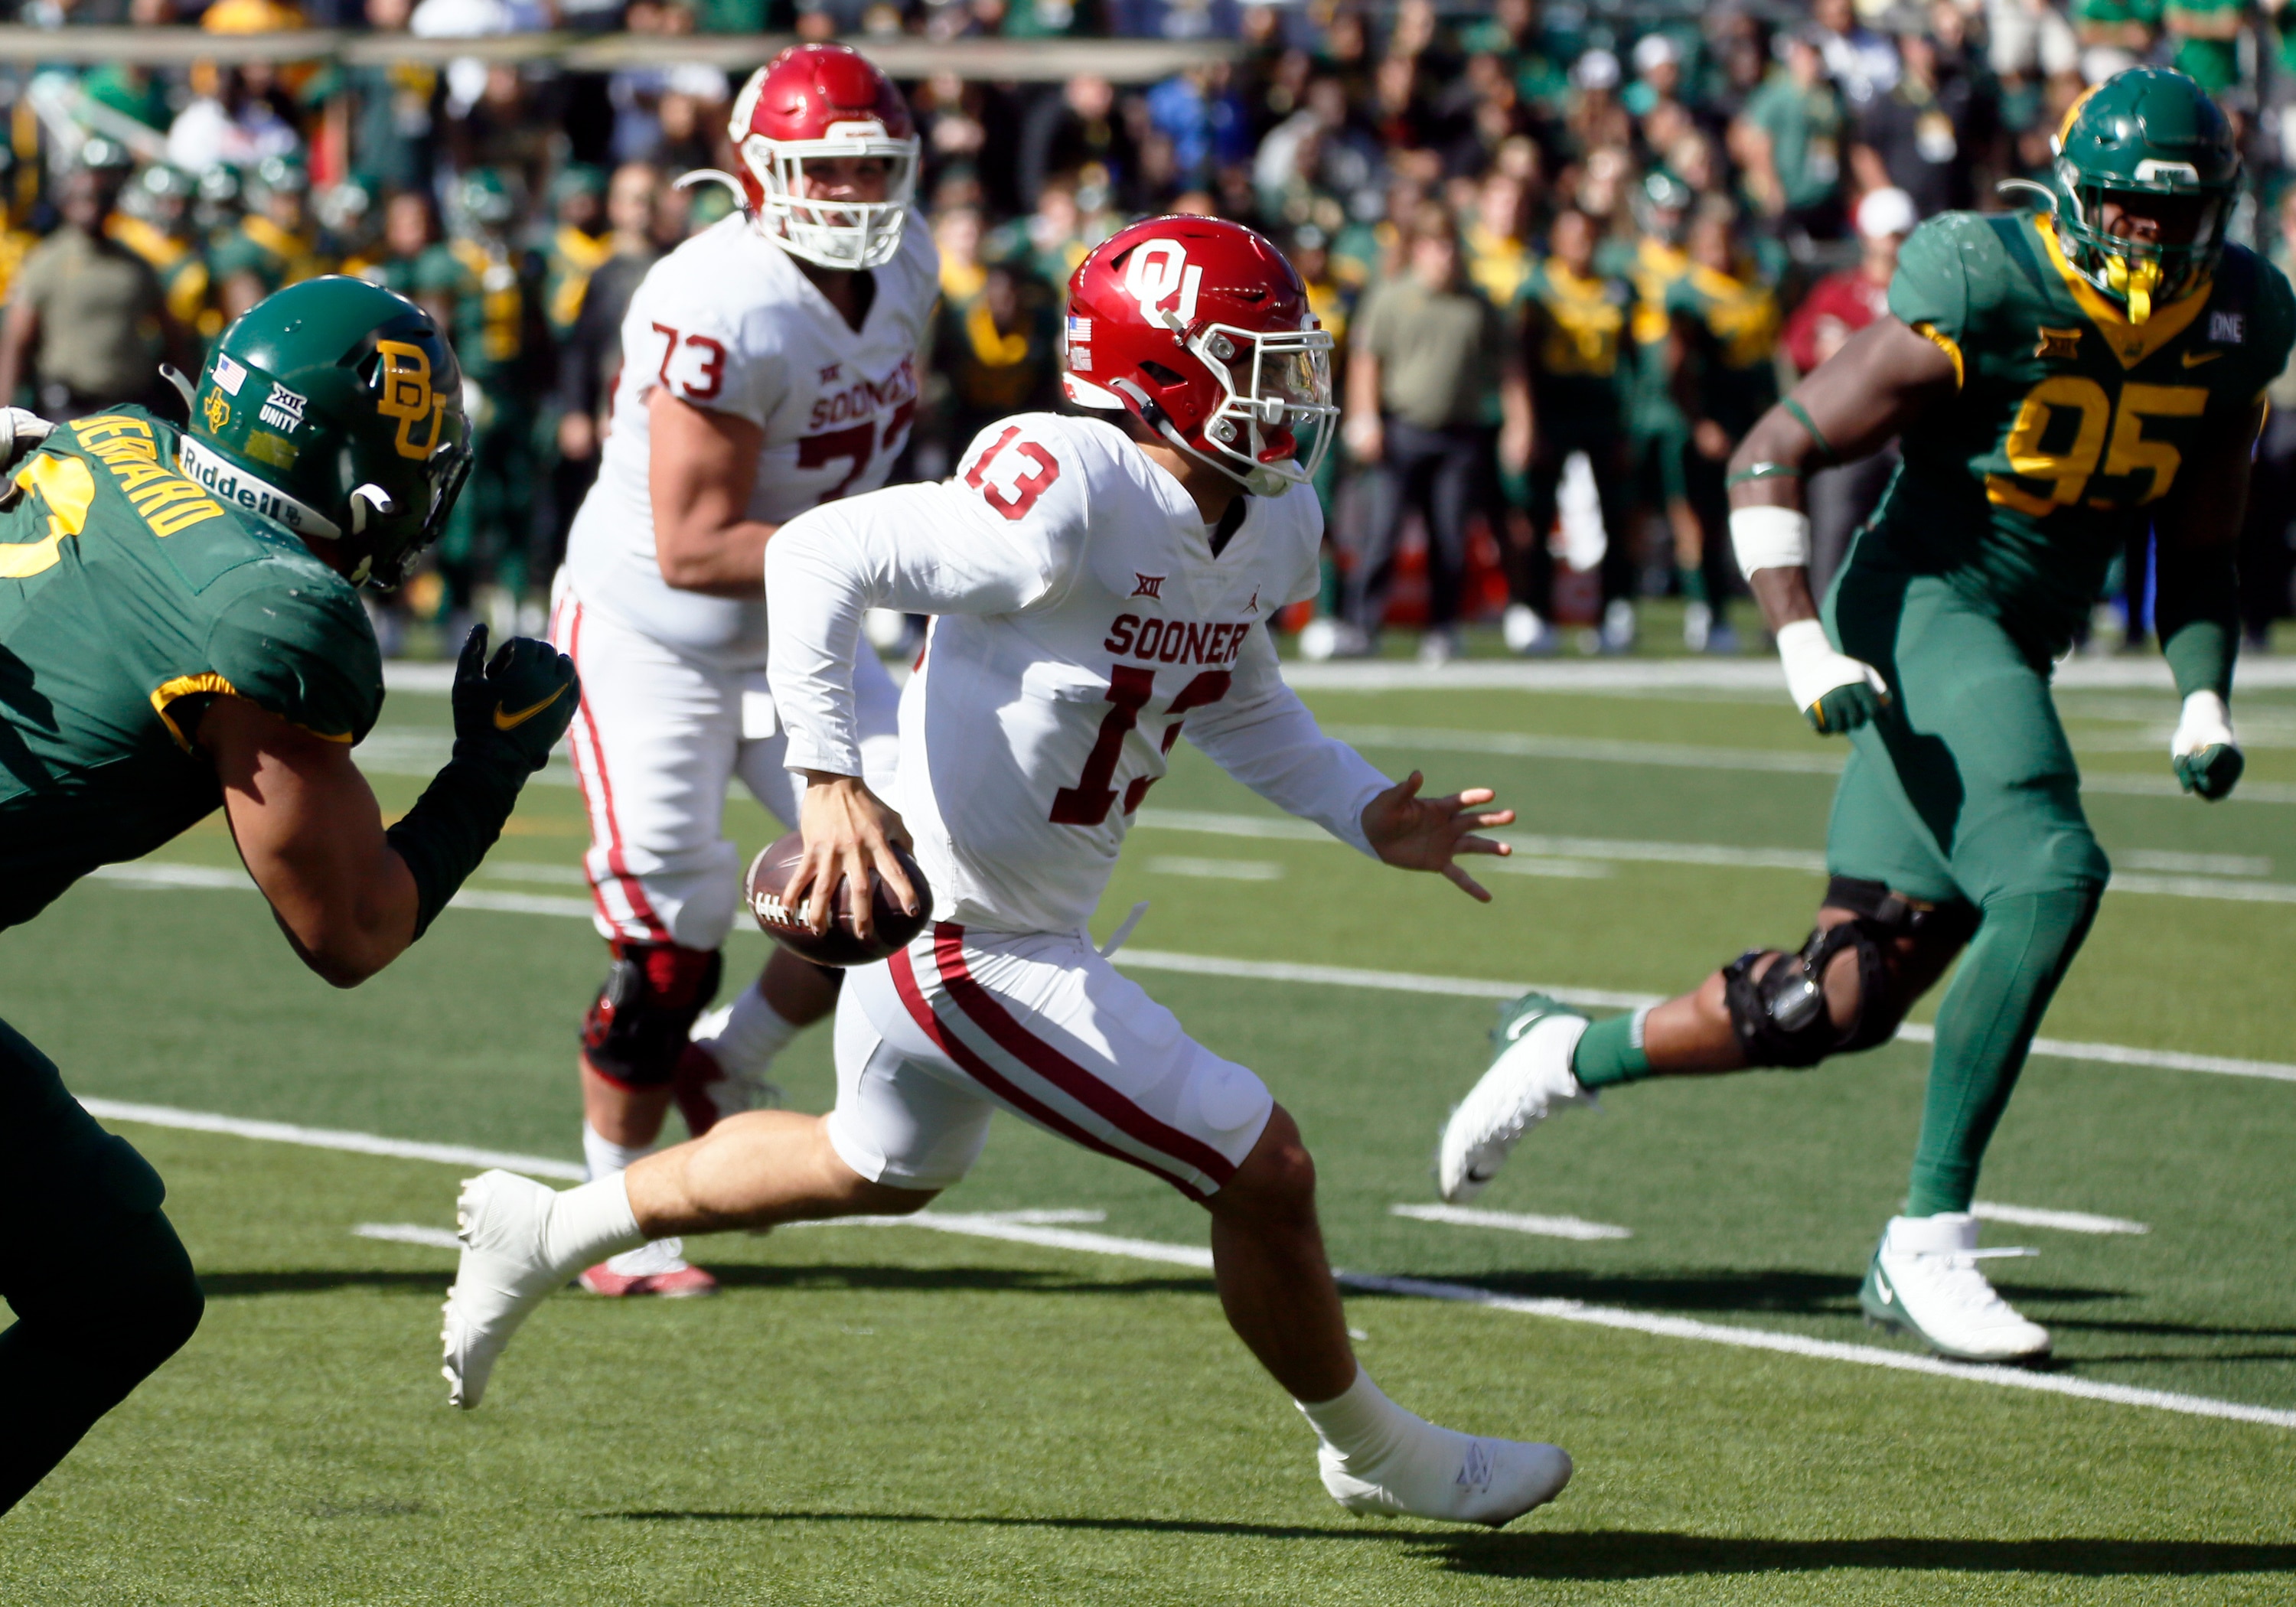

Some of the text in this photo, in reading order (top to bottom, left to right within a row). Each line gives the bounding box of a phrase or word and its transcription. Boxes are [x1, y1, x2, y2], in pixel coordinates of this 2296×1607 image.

[1124, 238, 1204, 330] OU
[377, 339, 446, 460] BU
[651, 321, 727, 400] 73
[259, 404, 302, 434] UNITY
[1986, 375, 2210, 517] 95
[184, 447, 281, 520] Riddell
[964, 425, 1061, 520] 13
[1130, 572, 1167, 600] XII
